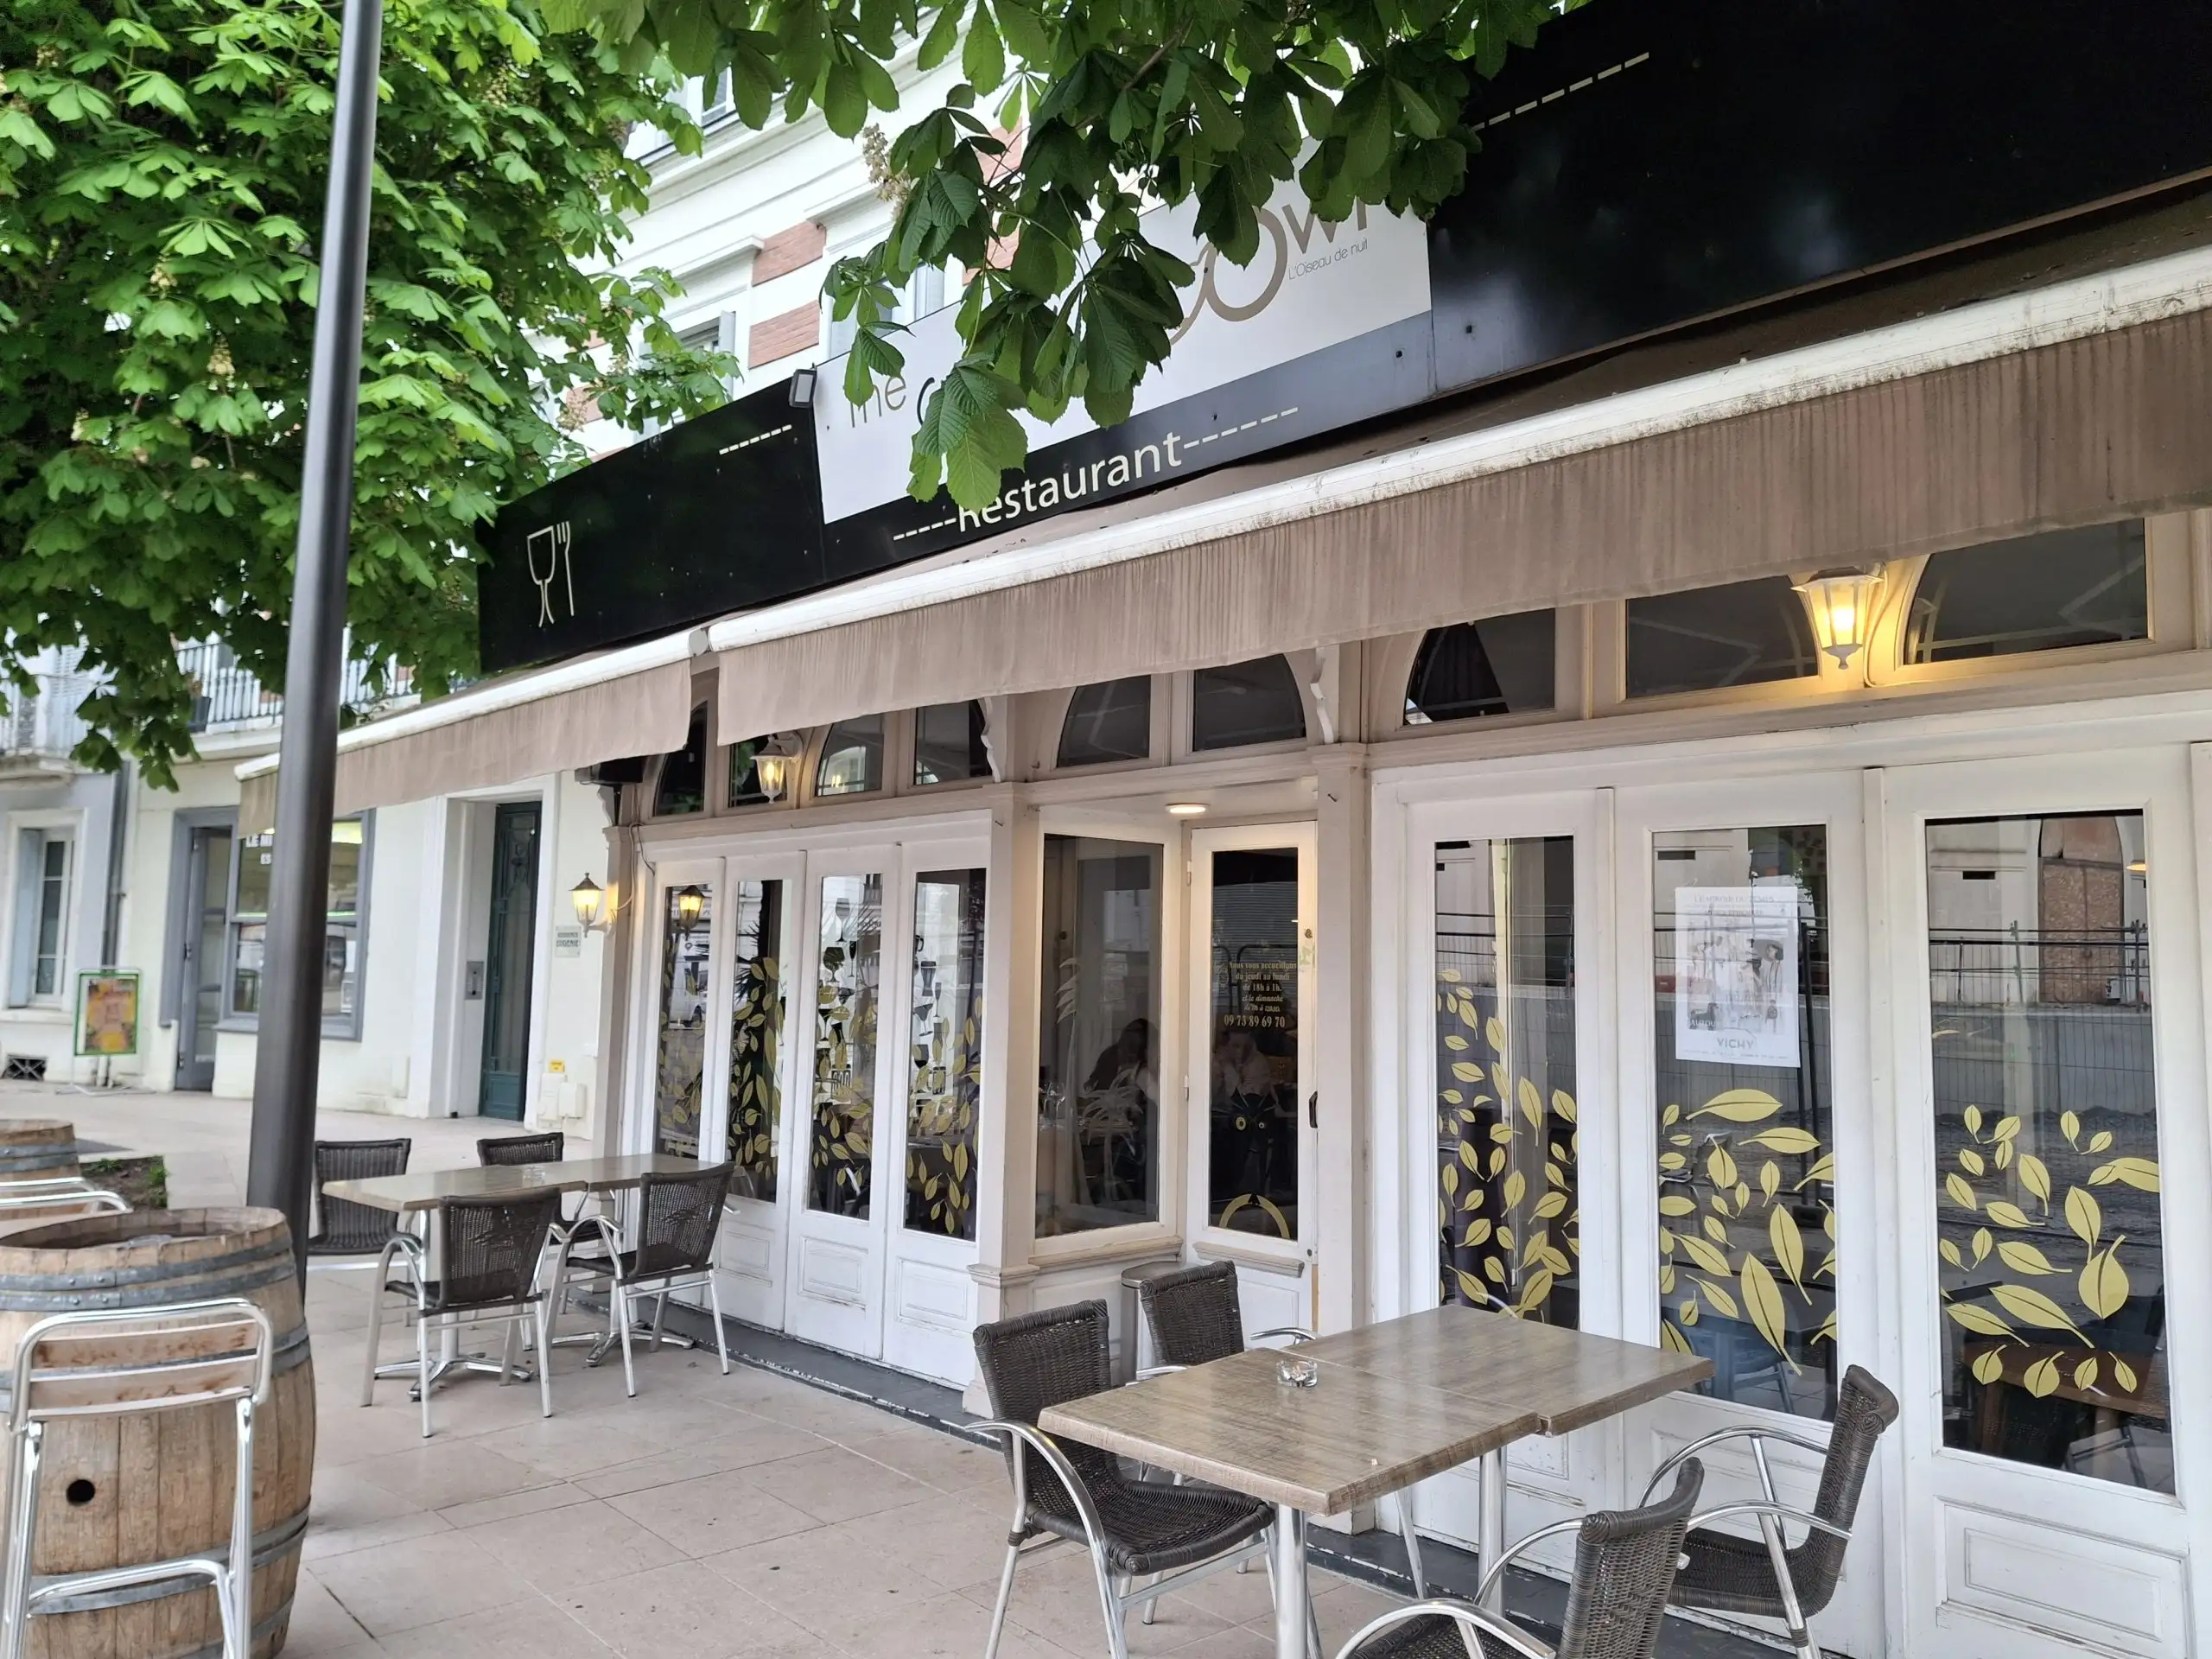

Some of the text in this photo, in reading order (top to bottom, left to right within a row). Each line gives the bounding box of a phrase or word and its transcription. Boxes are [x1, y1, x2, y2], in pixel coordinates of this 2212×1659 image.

[1288, 236, 1368, 280] L'Oiseau de nuit
[1224, 1014, 1286, 1028] 09 73 89 69 70
[1717, 1037, 1754, 1050] VICHY
